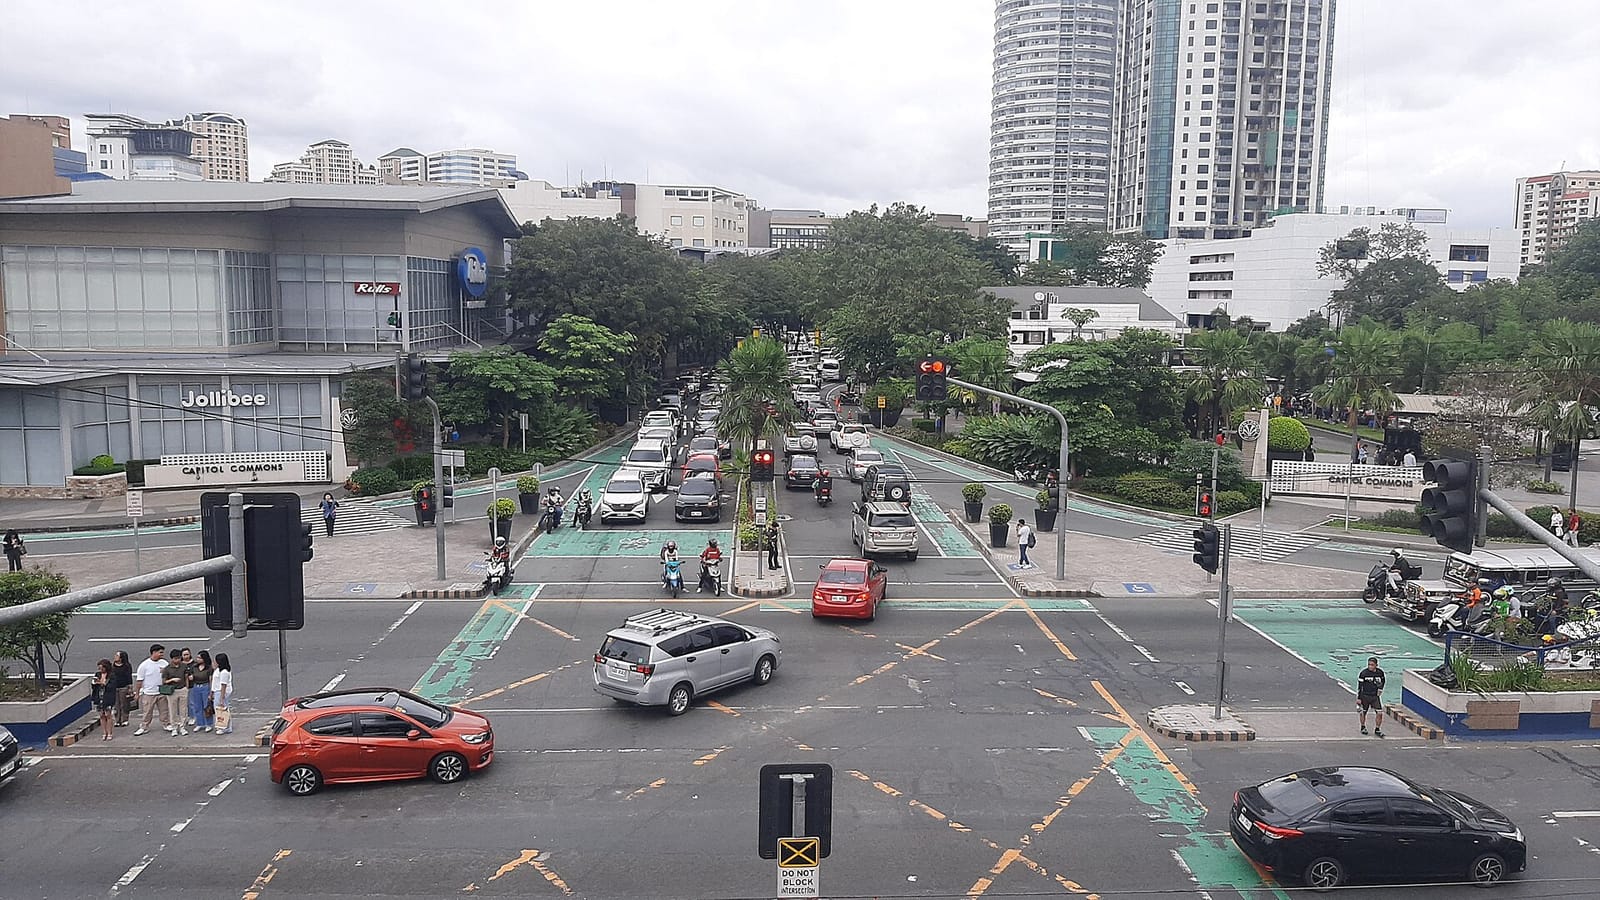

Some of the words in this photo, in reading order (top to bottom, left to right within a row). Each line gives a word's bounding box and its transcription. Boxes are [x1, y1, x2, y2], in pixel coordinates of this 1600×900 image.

[181, 389, 266, 407] Jollibee
[182, 466, 225, 475] CAPITOL
[230, 463, 283, 473] COMMONS
[797, 869, 815, 877] NOT
